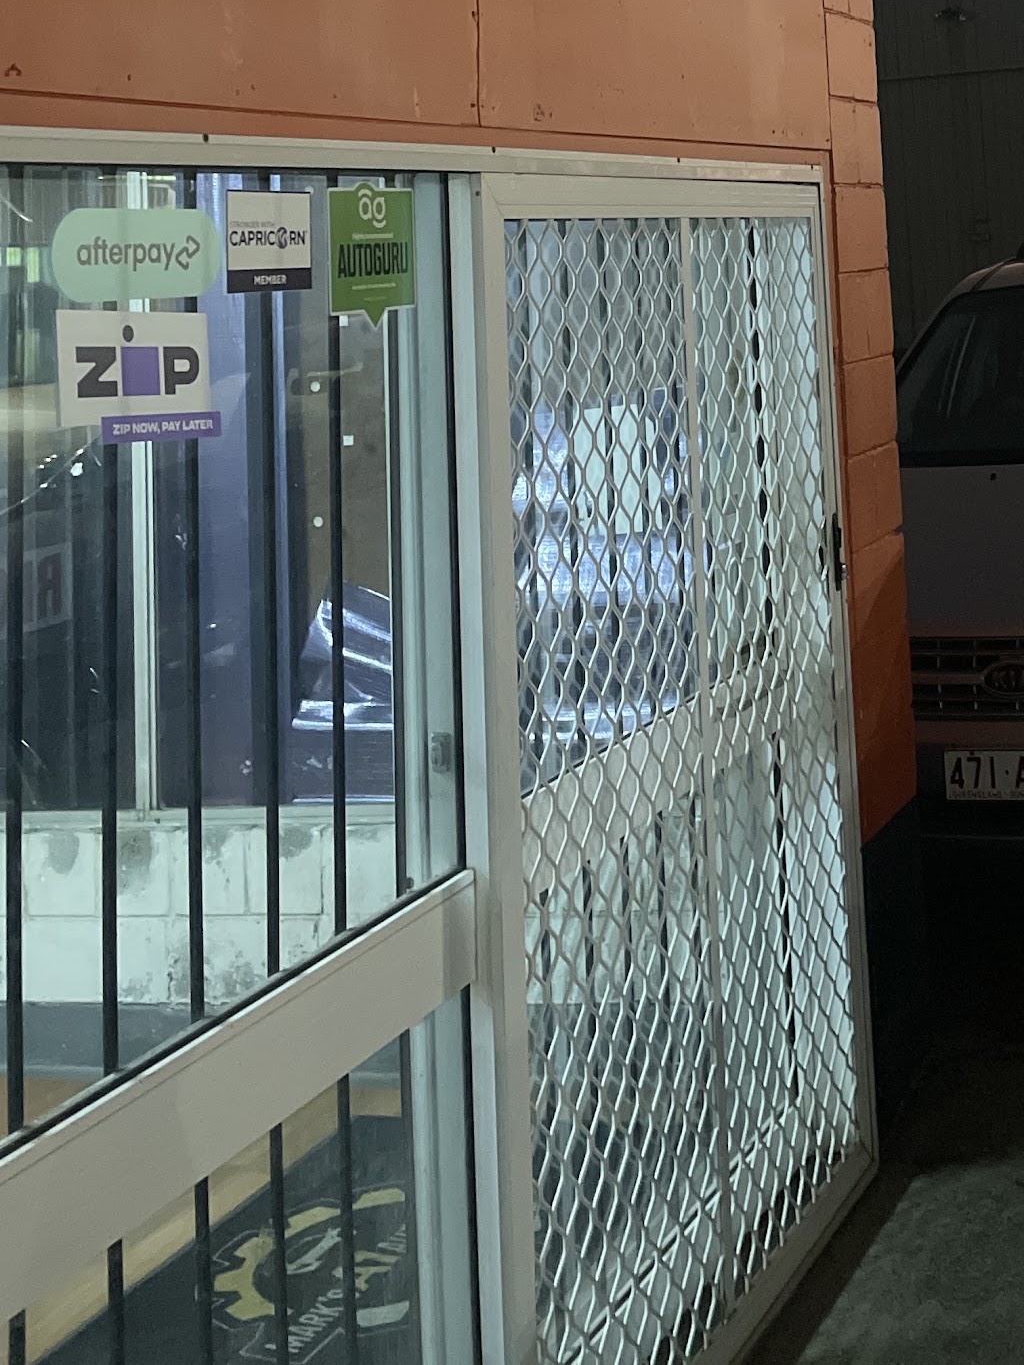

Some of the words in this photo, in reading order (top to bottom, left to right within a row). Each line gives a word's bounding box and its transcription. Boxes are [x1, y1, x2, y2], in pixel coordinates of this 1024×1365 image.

[76, 235, 175, 272] afterpay
[337, 241, 409, 279] AUTOGURU
[253, 274, 288, 285] MEMBER
[112, 423, 131, 435] ZIP
[132, 421, 161, 434] NOW,
[161, 420, 181, 432] PAY
[182, 419, 214, 431] LATER
